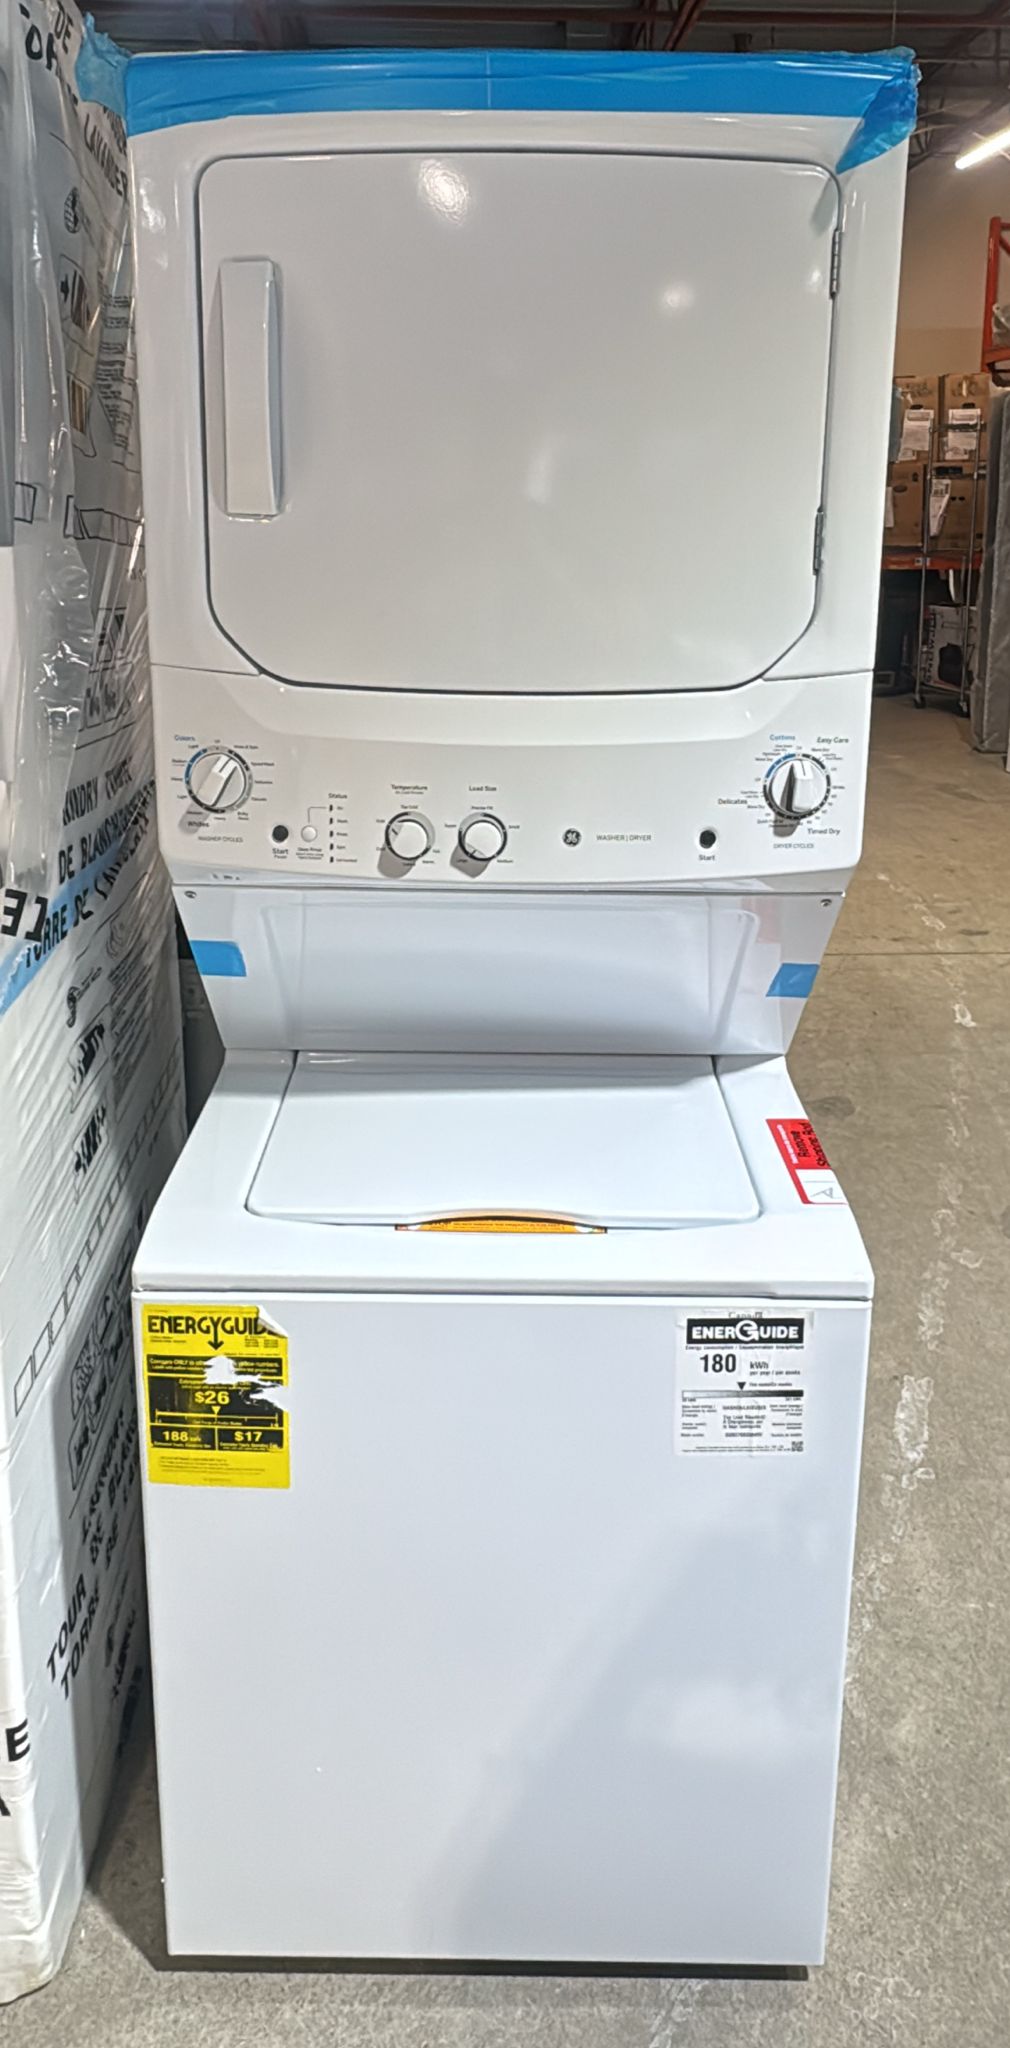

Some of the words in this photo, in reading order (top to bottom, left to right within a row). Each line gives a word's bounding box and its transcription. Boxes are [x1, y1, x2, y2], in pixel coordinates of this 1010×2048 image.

[829, 828, 841, 836] Dry
[596, 834, 625, 842] WASHER
[691, 1319, 799, 1342] ENERGUIDE
[699, 1353, 737, 1373] 180
[750, 1361, 769, 1369] kWh
[194, 1390, 230, 1405] $26
[162, 1431, 189, 1442] 188
[234, 1431, 263, 1443] $17
